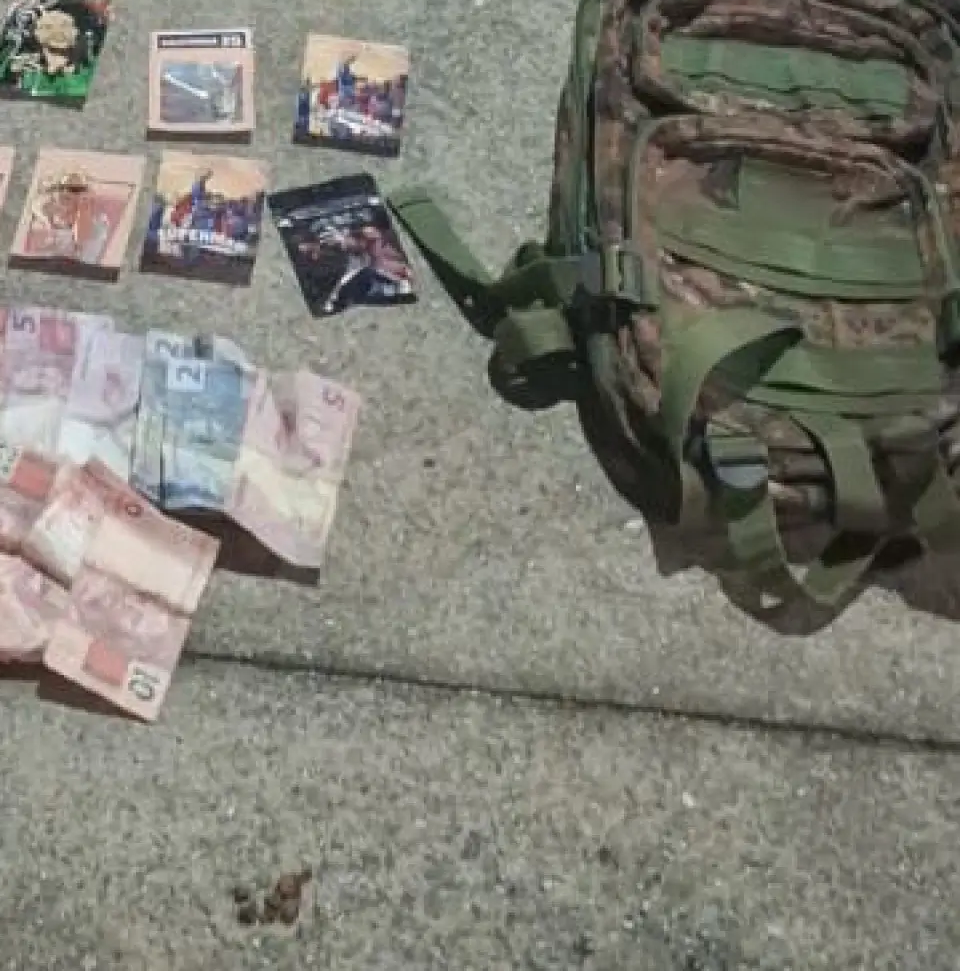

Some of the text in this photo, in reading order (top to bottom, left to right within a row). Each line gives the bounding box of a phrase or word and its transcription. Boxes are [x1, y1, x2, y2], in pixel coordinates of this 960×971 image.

[12, 310, 36, 332] 5
[155, 339, 180, 358] 2
[176, 364, 203, 384] 2
[321, 385, 345, 413] 5
[127, 666, 161, 704] 10
